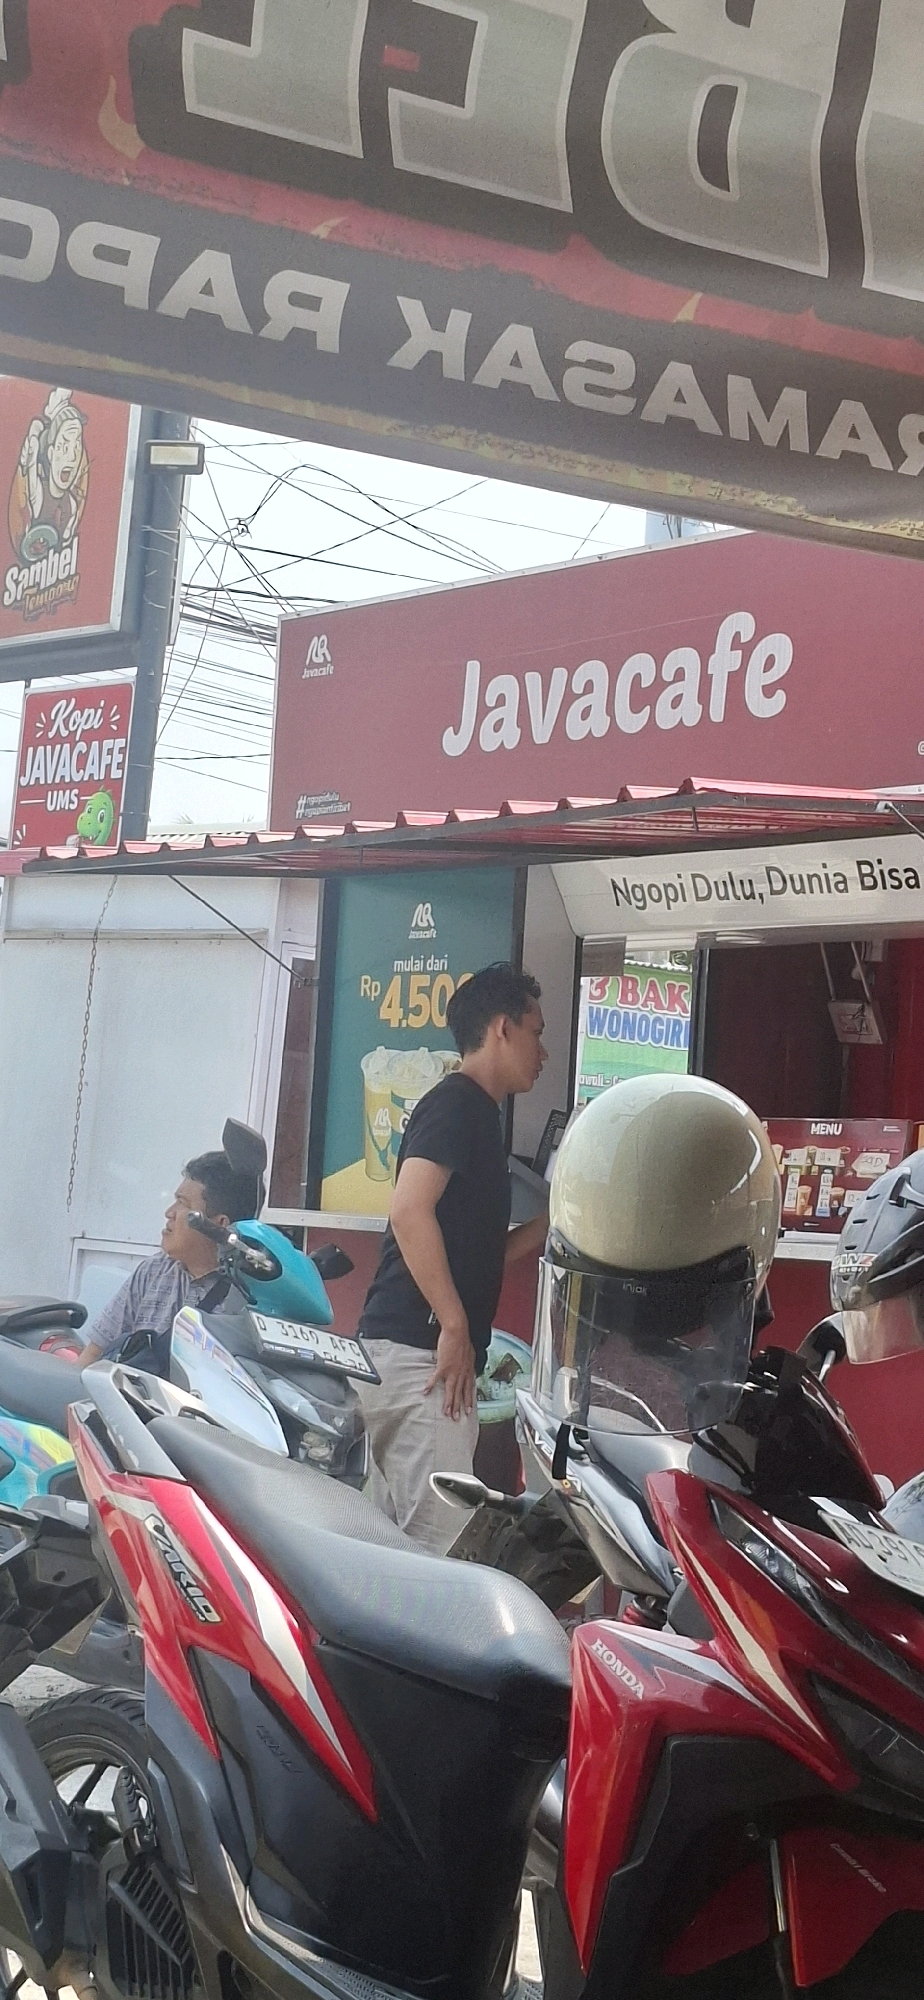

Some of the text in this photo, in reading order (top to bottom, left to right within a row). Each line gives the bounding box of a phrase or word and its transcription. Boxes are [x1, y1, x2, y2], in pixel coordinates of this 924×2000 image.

[3, 536, 79, 606] Sambel
[301, 663, 335, 680] Javacafe
[442, 611, 794, 757] Javacafe
[48, 697, 105, 741] Kopi
[20, 738, 126, 787] JAVACAFE
[47, 788, 79, 812] UMS
[610, 858, 921, 910] Ngopi Dulu, Dunia Bisa
[394, 954, 448, 972] mulai dari
[361, 972, 475, 1028] Rp 4.50
[811, 1122, 843, 1136] MENU
[832, 1518, 875, 1550] AD
[143, 1513, 222, 1622] VARIO
[590, 1638, 645, 1700] HONDA
